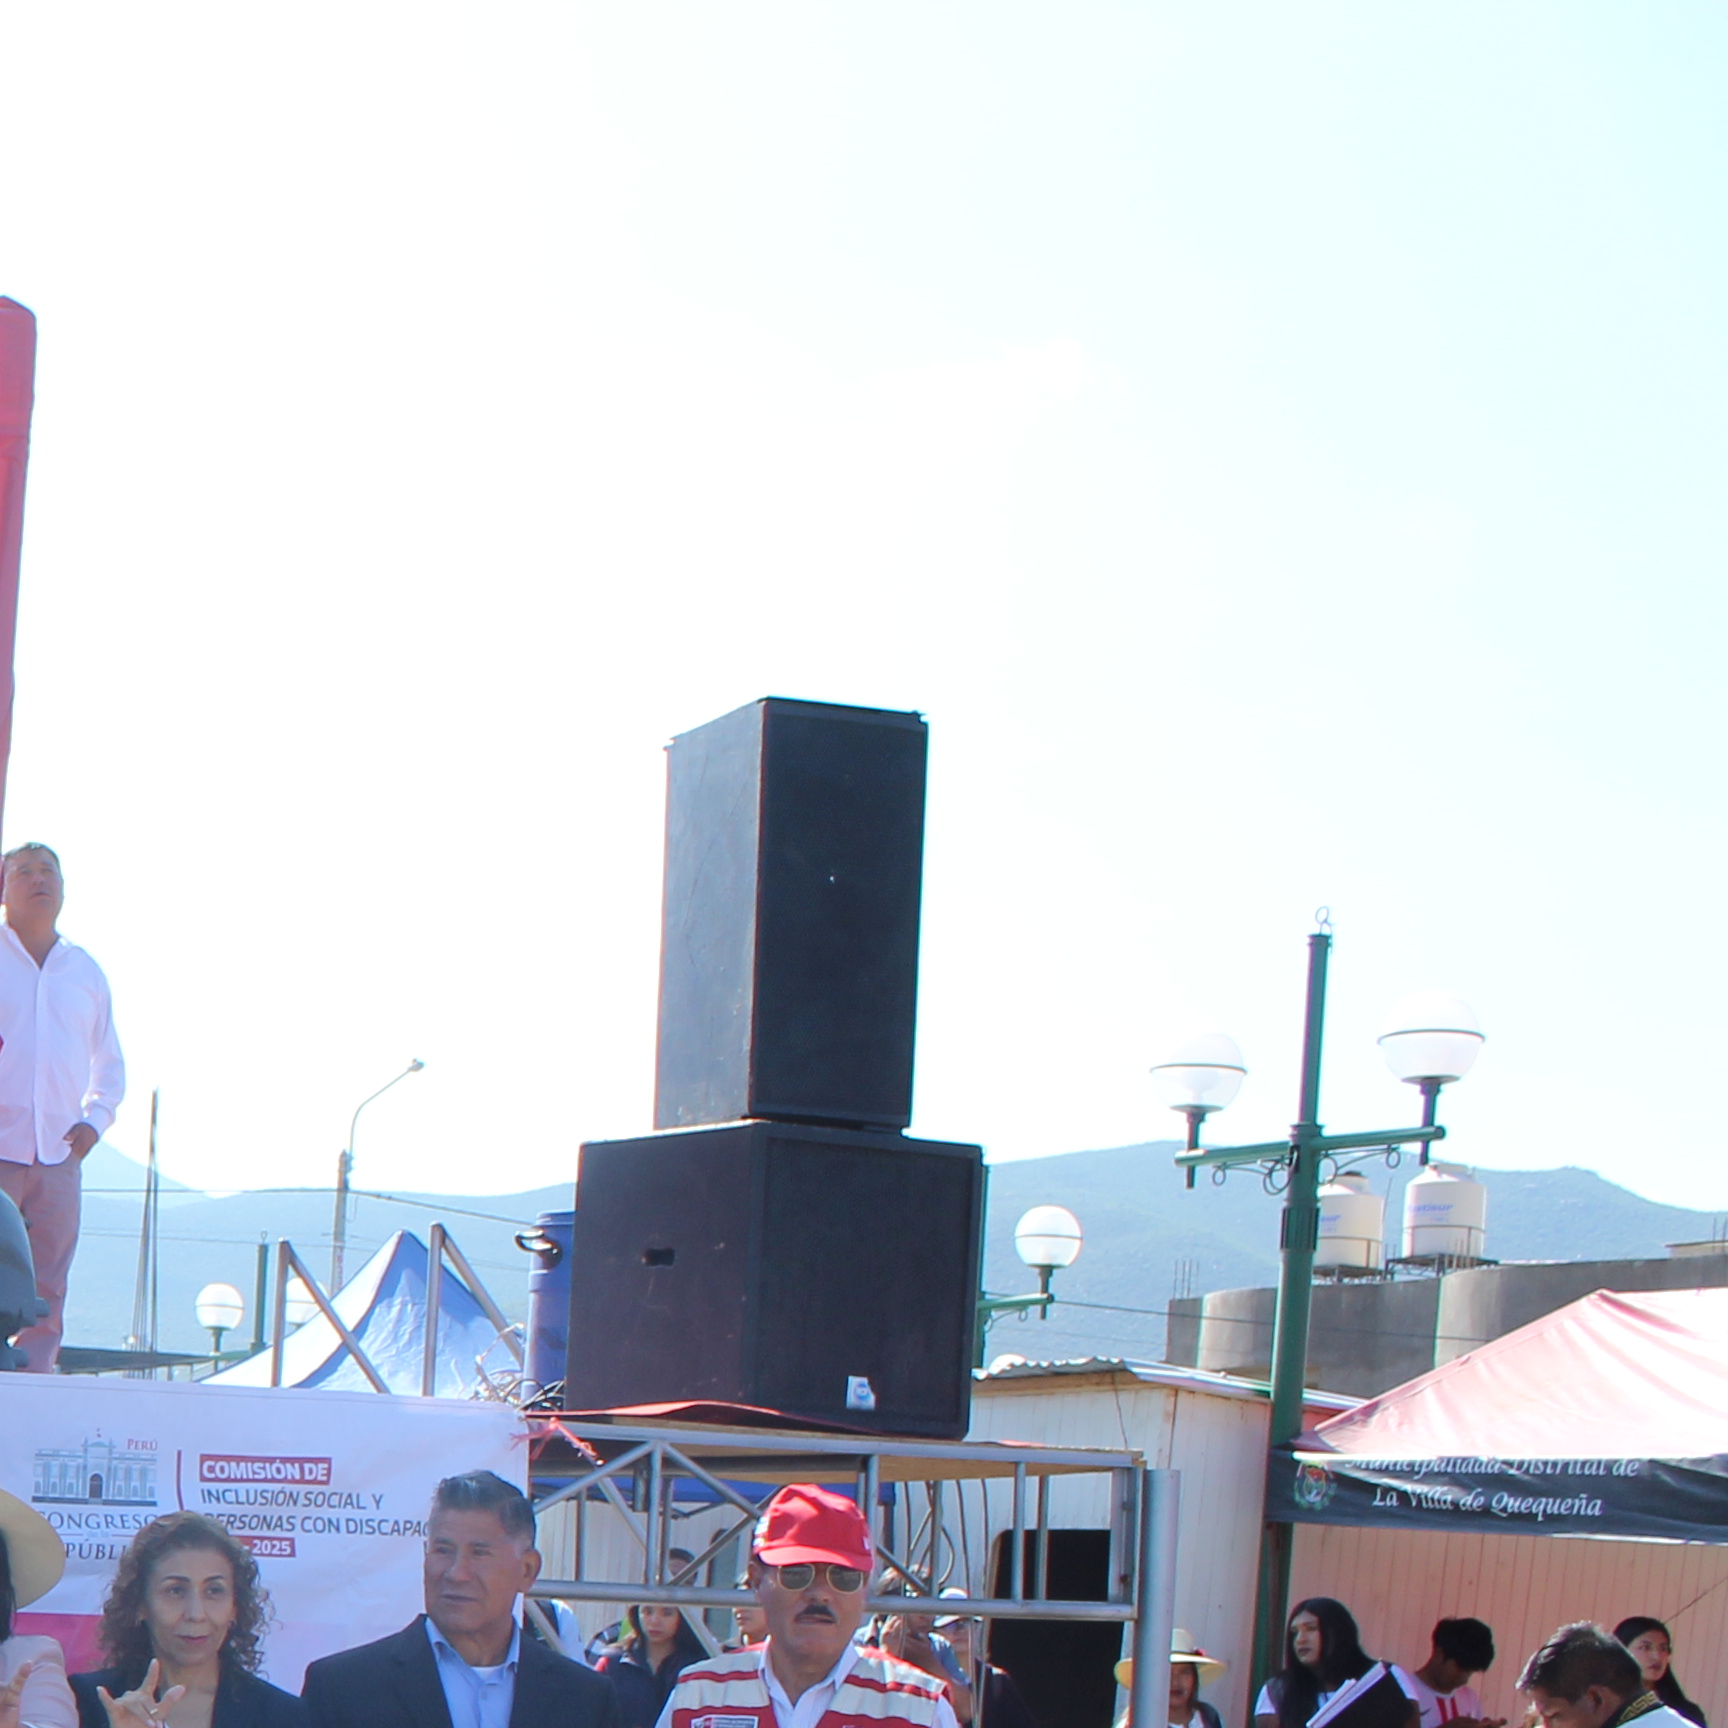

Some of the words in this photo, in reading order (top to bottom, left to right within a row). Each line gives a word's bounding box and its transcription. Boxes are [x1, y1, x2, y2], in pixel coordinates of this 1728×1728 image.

[126, 1437, 159, 1452] PERÚ
[201, 1459, 301, 1481] COMISIÓN
[303, 1462, 330, 1482] DE
[200, 1486, 301, 1508] INCLUSIÓN
[301, 1490, 367, 1510] SOCIAL
[370, 1493, 384, 1510] Y
[1372, 1486, 1399, 1508] La
[1490, 1491, 1603, 1522] Quequeña
[300, 1516, 341, 1534] CON
[250, 1539, 292, 1555] 2025
